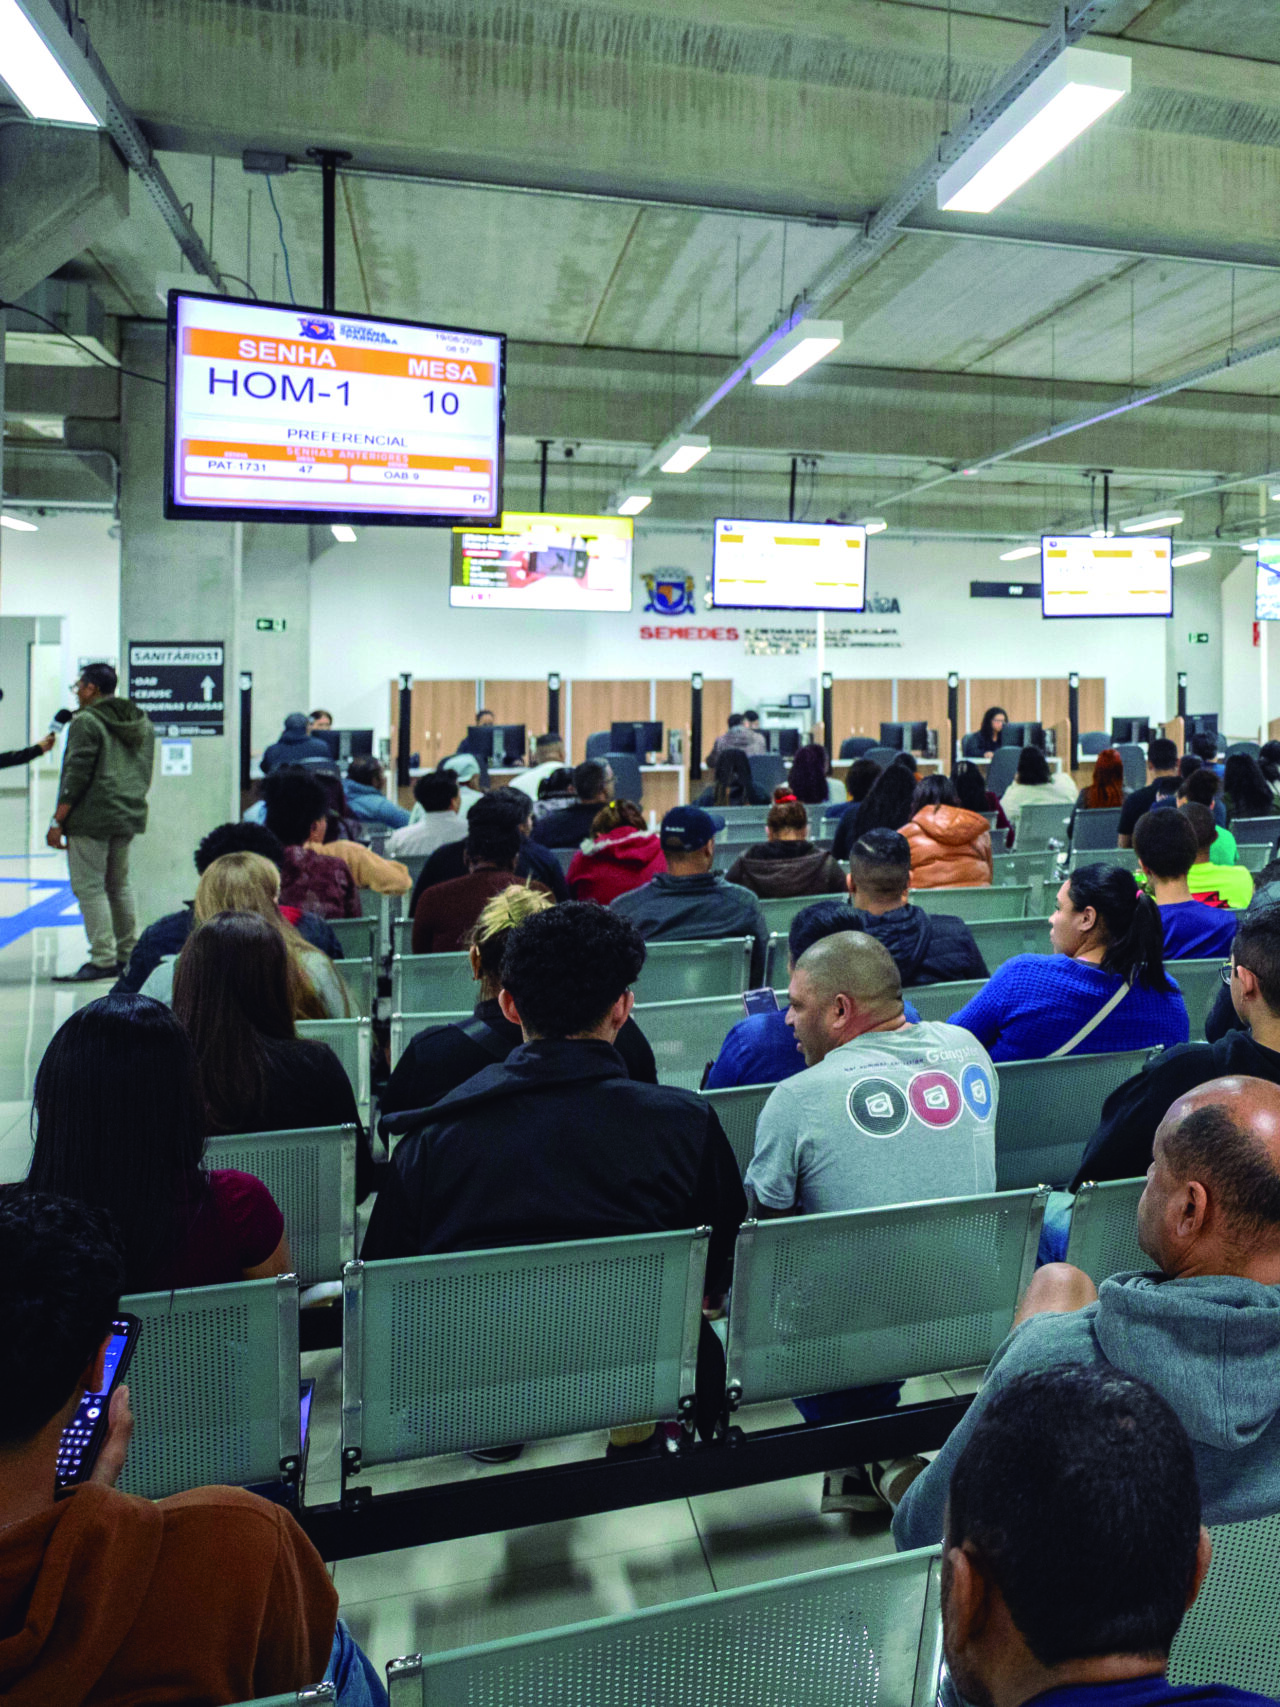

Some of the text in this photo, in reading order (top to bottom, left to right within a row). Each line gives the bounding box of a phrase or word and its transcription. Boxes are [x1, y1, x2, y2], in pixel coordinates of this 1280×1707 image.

[238, 339, 337, 367] SENHA
[408, 357, 478, 383] MESA
[209, 367, 349, 407] HOM-1
[423, 390, 459, 416] 10
[287, 428, 408, 448] PREFERENCIAL
[286, 446, 334, 458] SENHAS
[299, 465, 313, 474] 47
[640, 627, 740, 640] SEMEDES
